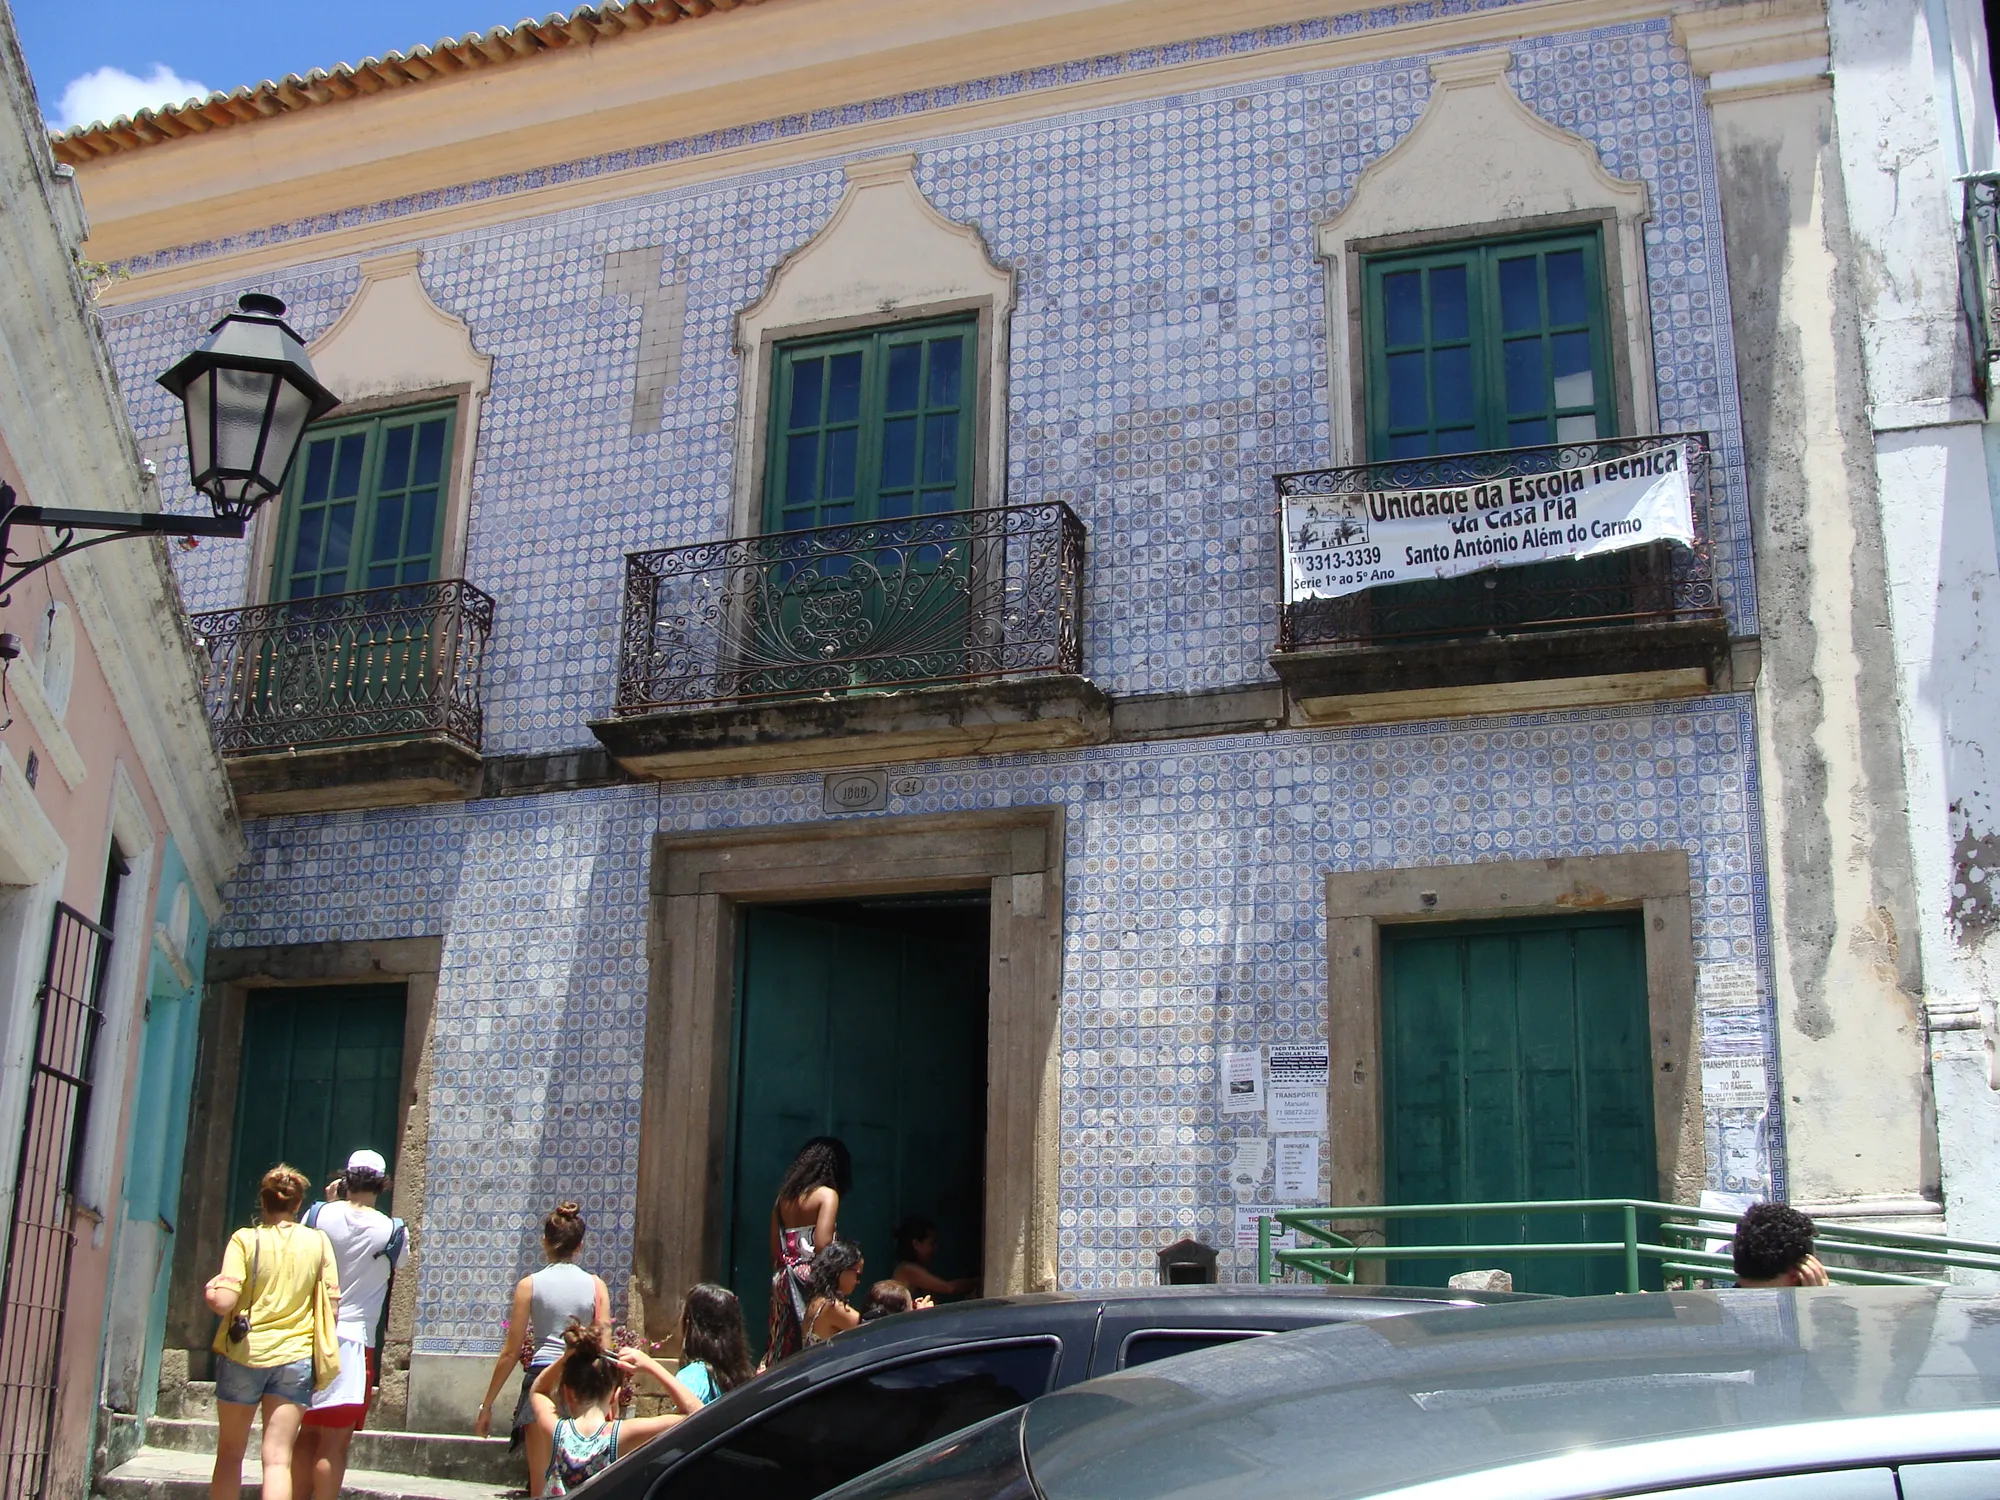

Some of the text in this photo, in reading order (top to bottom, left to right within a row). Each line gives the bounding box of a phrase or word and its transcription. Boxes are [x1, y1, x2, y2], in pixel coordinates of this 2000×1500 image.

[1369, 489, 1468, 522] Unidade
[1474, 485, 1506, 511] da
[1510, 471, 1585, 505] Escola
[1485, 506, 1537, 531] Casa
[1544, 496, 1578, 523] Pia
[1405, 543, 1450, 566] Santo
[1453, 531, 1519, 560] Antônio
[1522, 526, 1564, 551] Além
[1567, 523, 1588, 543] do
[1591, 516, 1643, 540] Carmo
[1305, 546, 1382, 572] 3313-3339
[1339, 575, 1354, 585] ao
[1370, 568, 1395, 581] Ano
[1703, 1058, 1767, 1069] TRANSPORTE ESCOLAR
[1731, 1070, 1740, 1079] DO
[1719, 1081, 1729, 1090] TIO
